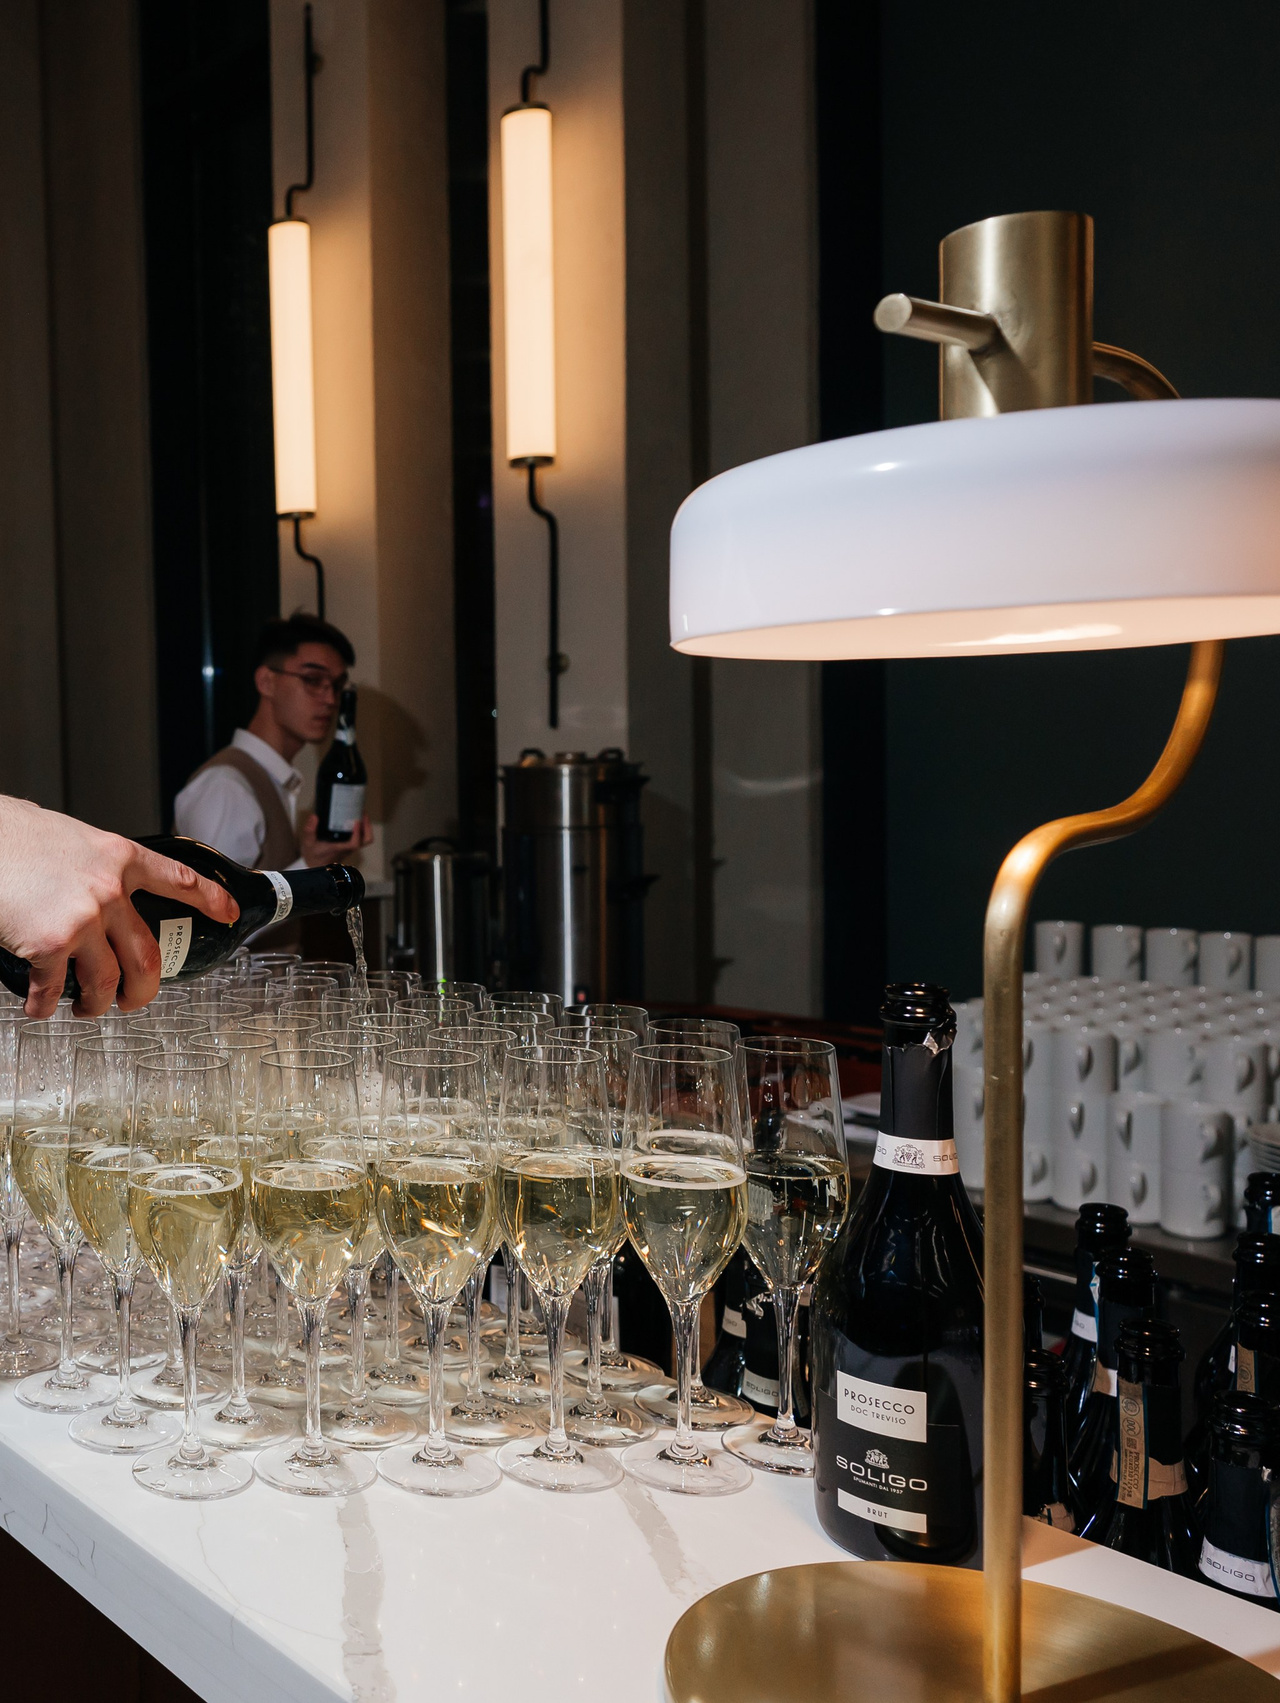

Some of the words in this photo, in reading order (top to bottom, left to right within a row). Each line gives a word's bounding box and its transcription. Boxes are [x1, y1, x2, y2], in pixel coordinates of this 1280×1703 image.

[165, 925, 184, 974] PROSECCO
[843, 1388, 915, 1415] PROSECCO
[850, 1404, 869, 1417] DOC
[871, 1411, 907, 1426] TREVISO
[835, 1454, 928, 1492] SOLIGO
[852, 1475, 878, 1489] SPUMANTI
[878, 1484, 890, 1492] DAL
[1132, 1451, 1140, 1490] PROSECCO
[866, 1506, 888, 1519] BRUT
[1205, 1556, 1256, 1583] SOLIGO
